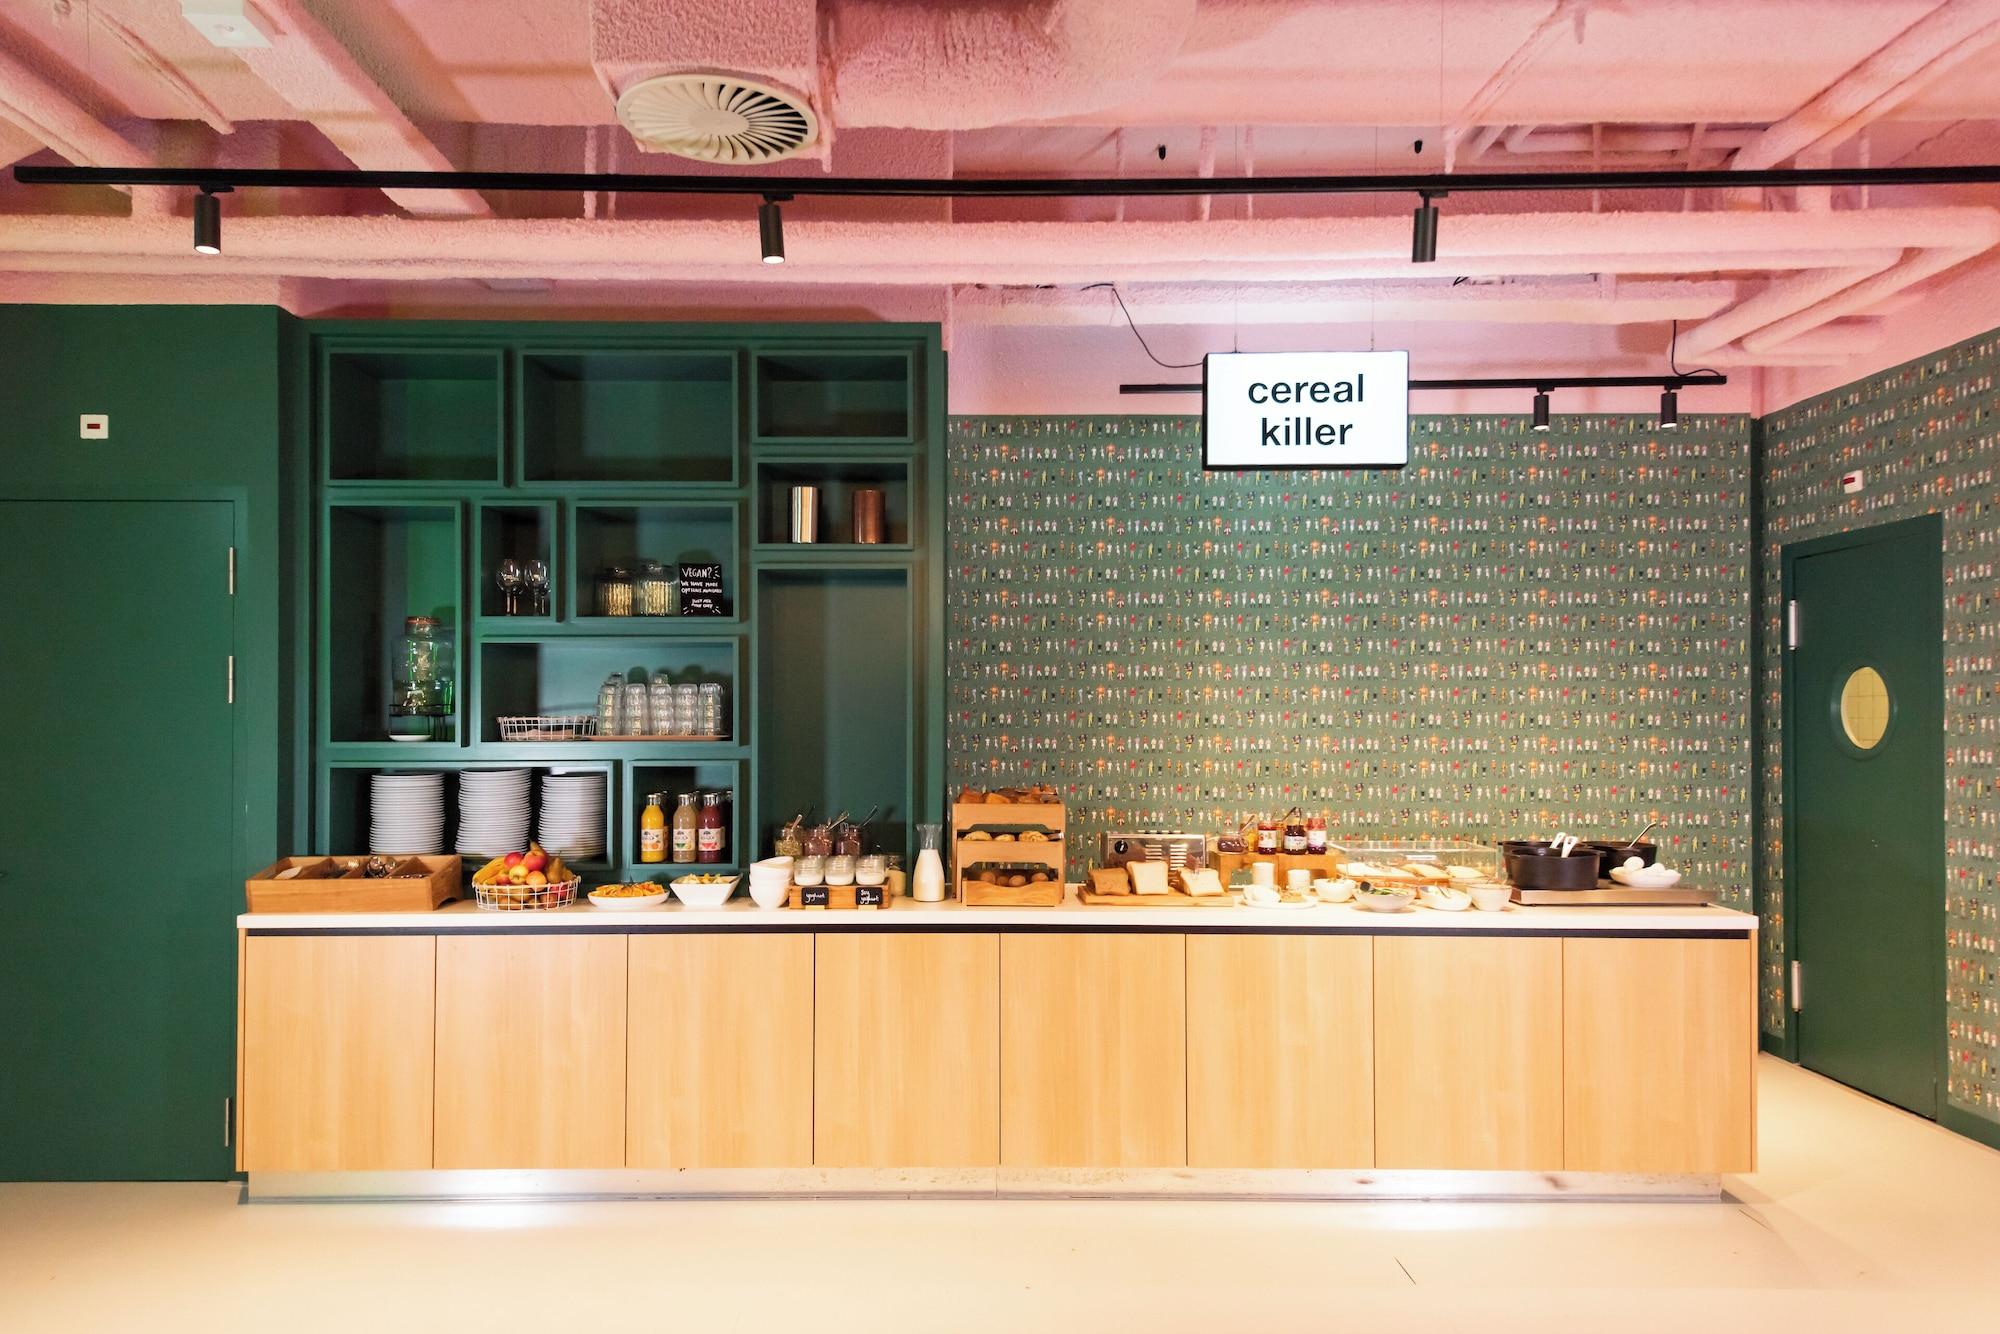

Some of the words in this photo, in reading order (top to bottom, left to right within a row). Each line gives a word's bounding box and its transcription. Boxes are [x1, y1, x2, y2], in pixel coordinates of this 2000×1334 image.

[1248, 373, 1364, 404] cereal
[1261, 417, 1353, 446] killer
[682, 567, 712, 578] VEGAN?
